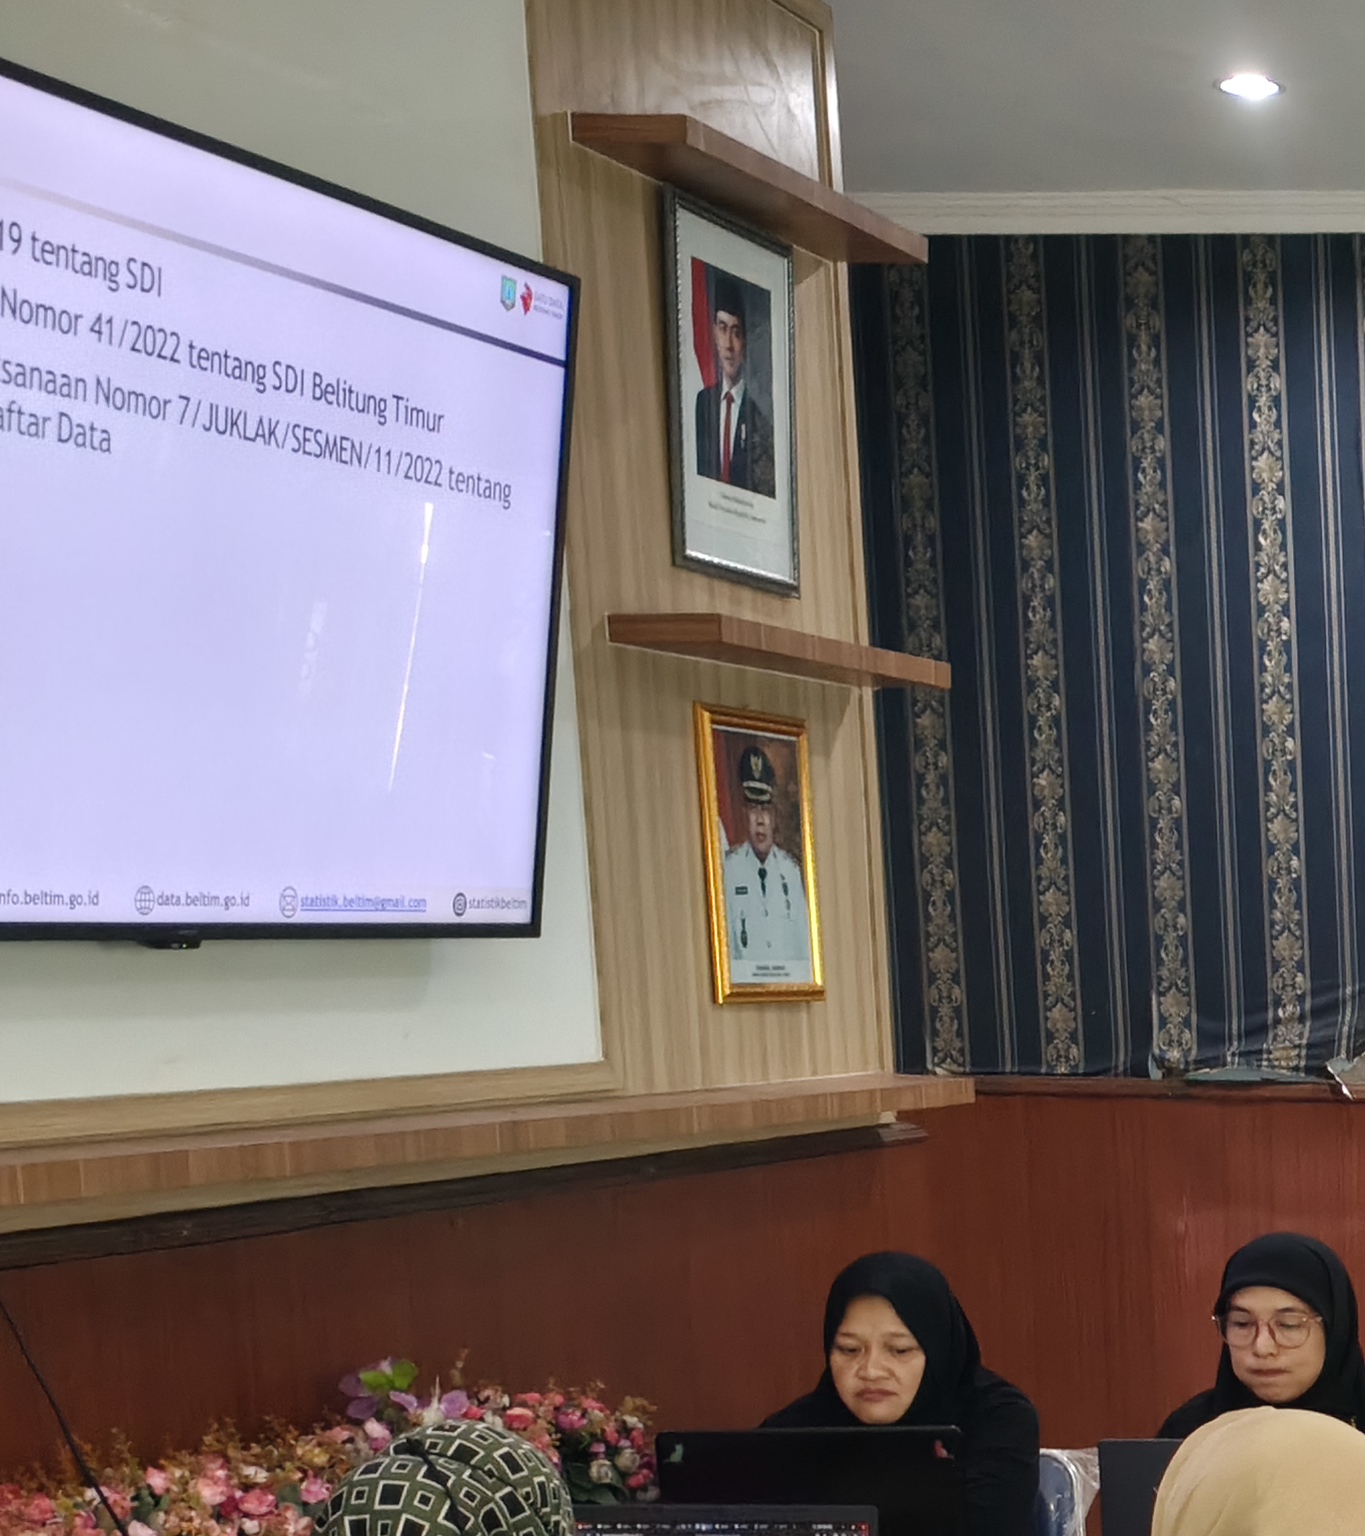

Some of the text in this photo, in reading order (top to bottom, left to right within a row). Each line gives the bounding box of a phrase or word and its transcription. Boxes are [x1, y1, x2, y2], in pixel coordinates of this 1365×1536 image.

[31, 231, 120, 292] tentang
[126, 257, 162, 297] SDI
[0, 286, 445, 434] Nomor 41/2022 tentang SDI Belitung Timur
[1, 358, 88, 402] sanaan
[95, 375, 172, 421] Nomor
[448, 465, 513, 510] tentang
[57, 411, 112, 455] Data
[157, 891, 250, 911] data.beltim.go.id
